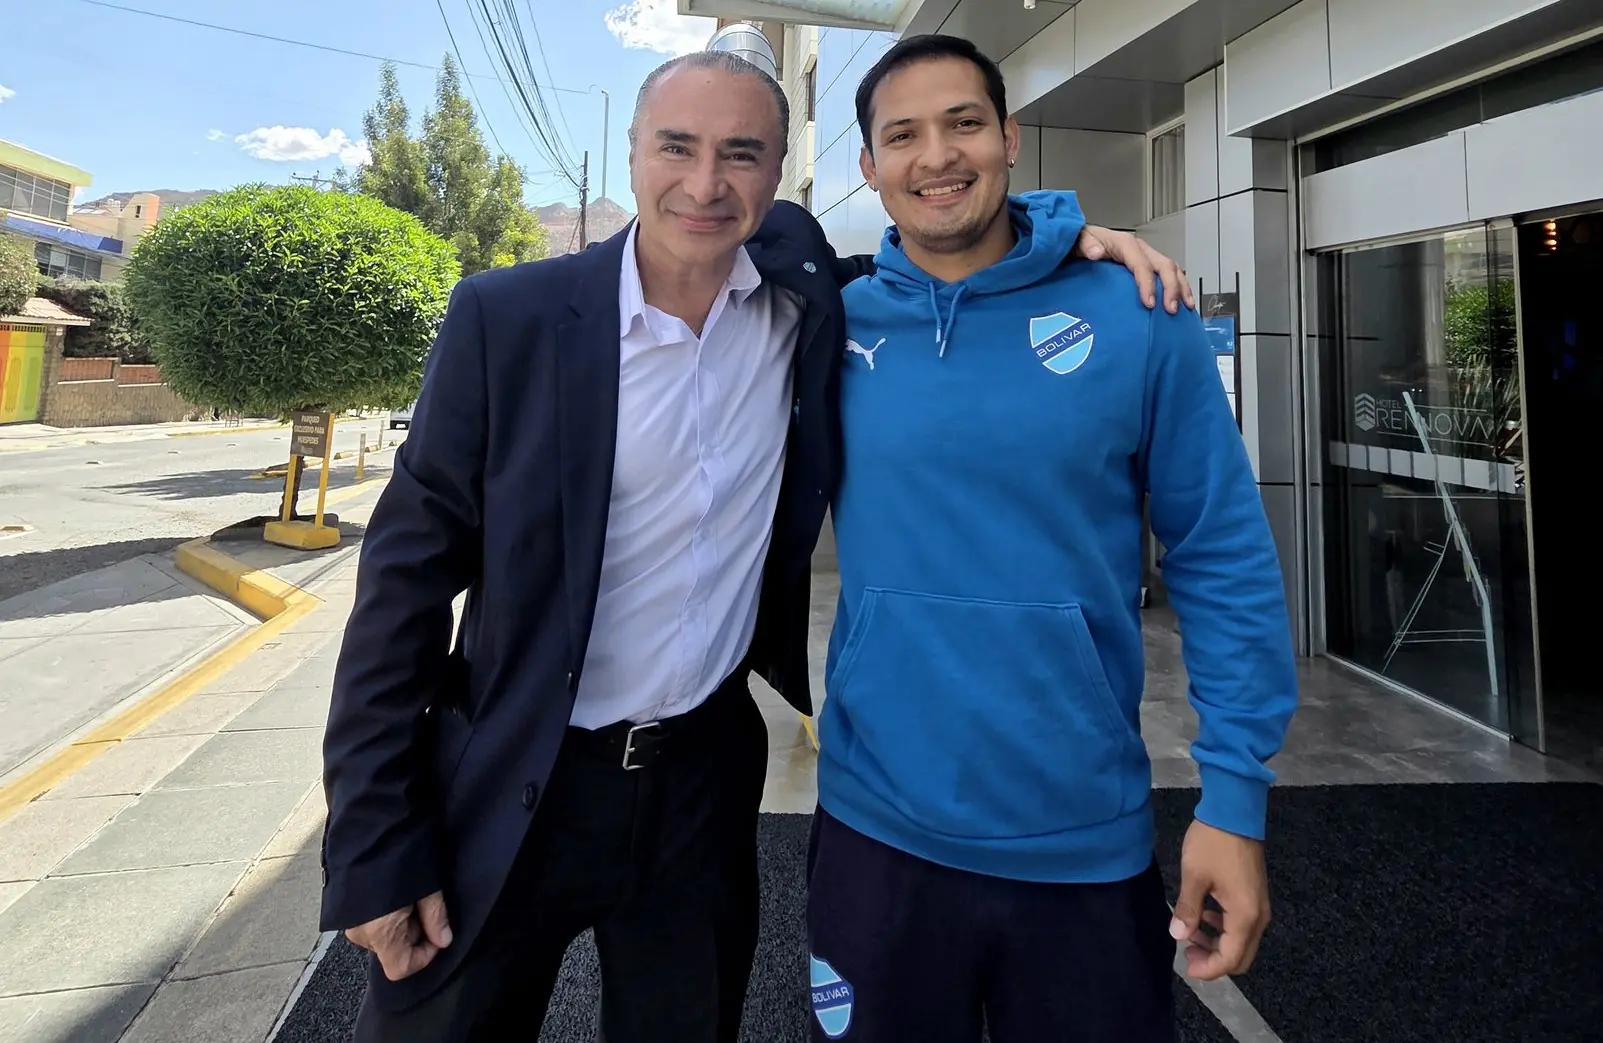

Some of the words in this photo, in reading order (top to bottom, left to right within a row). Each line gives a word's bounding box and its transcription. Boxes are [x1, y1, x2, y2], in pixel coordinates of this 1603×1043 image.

[1036, 323, 1091, 358] BOLIVAR
[1375, 399, 1401, 409] HOTEL
[811, 986, 850, 1003] BOLIVAR
